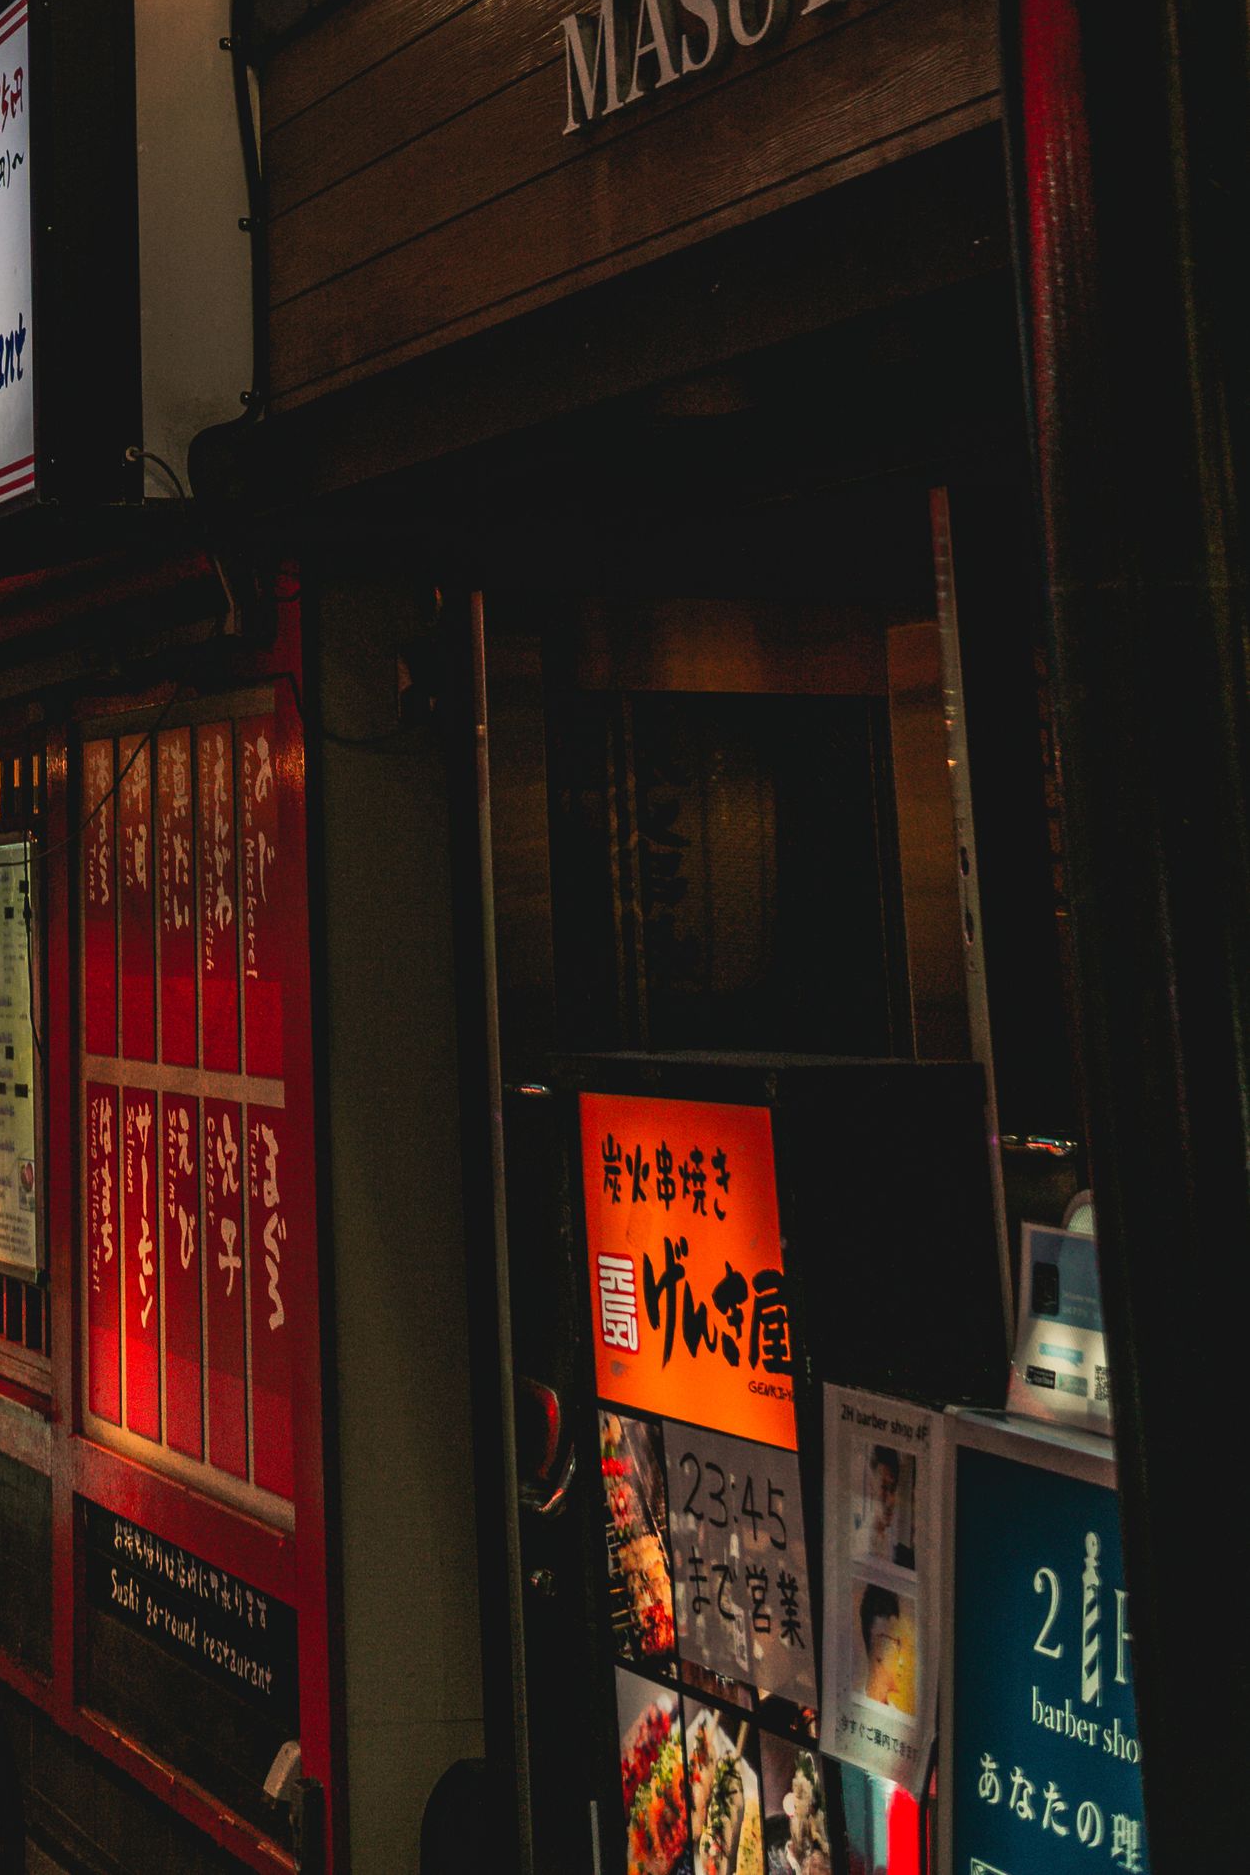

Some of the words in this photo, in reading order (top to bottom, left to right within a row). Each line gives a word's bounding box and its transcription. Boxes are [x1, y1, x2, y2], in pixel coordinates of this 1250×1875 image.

[245, 837, 259, 979] Mackerel
[125, 1105, 135, 1195] Salmon
[167, 1108, 177, 1220] Shrimp
[206, 1116, 215, 1225] Conger
[250, 1122, 260, 1198] Tuna
[601, 1132, 731, 1222] 炭火串焼き
[642, 1235, 793, 1375] げんき屋
[679, 1451, 787, 1551] 23:45
[110, 1567, 140, 1615] Sushi
[146, 1596, 197, 1649] go-round
[202, 1629, 273, 1696] restaurant
[688, 1545, 806, 1650] まで営業
[1032, 1685, 1099, 1746] barber
[1102, 1717, 1142, 1764] sho
